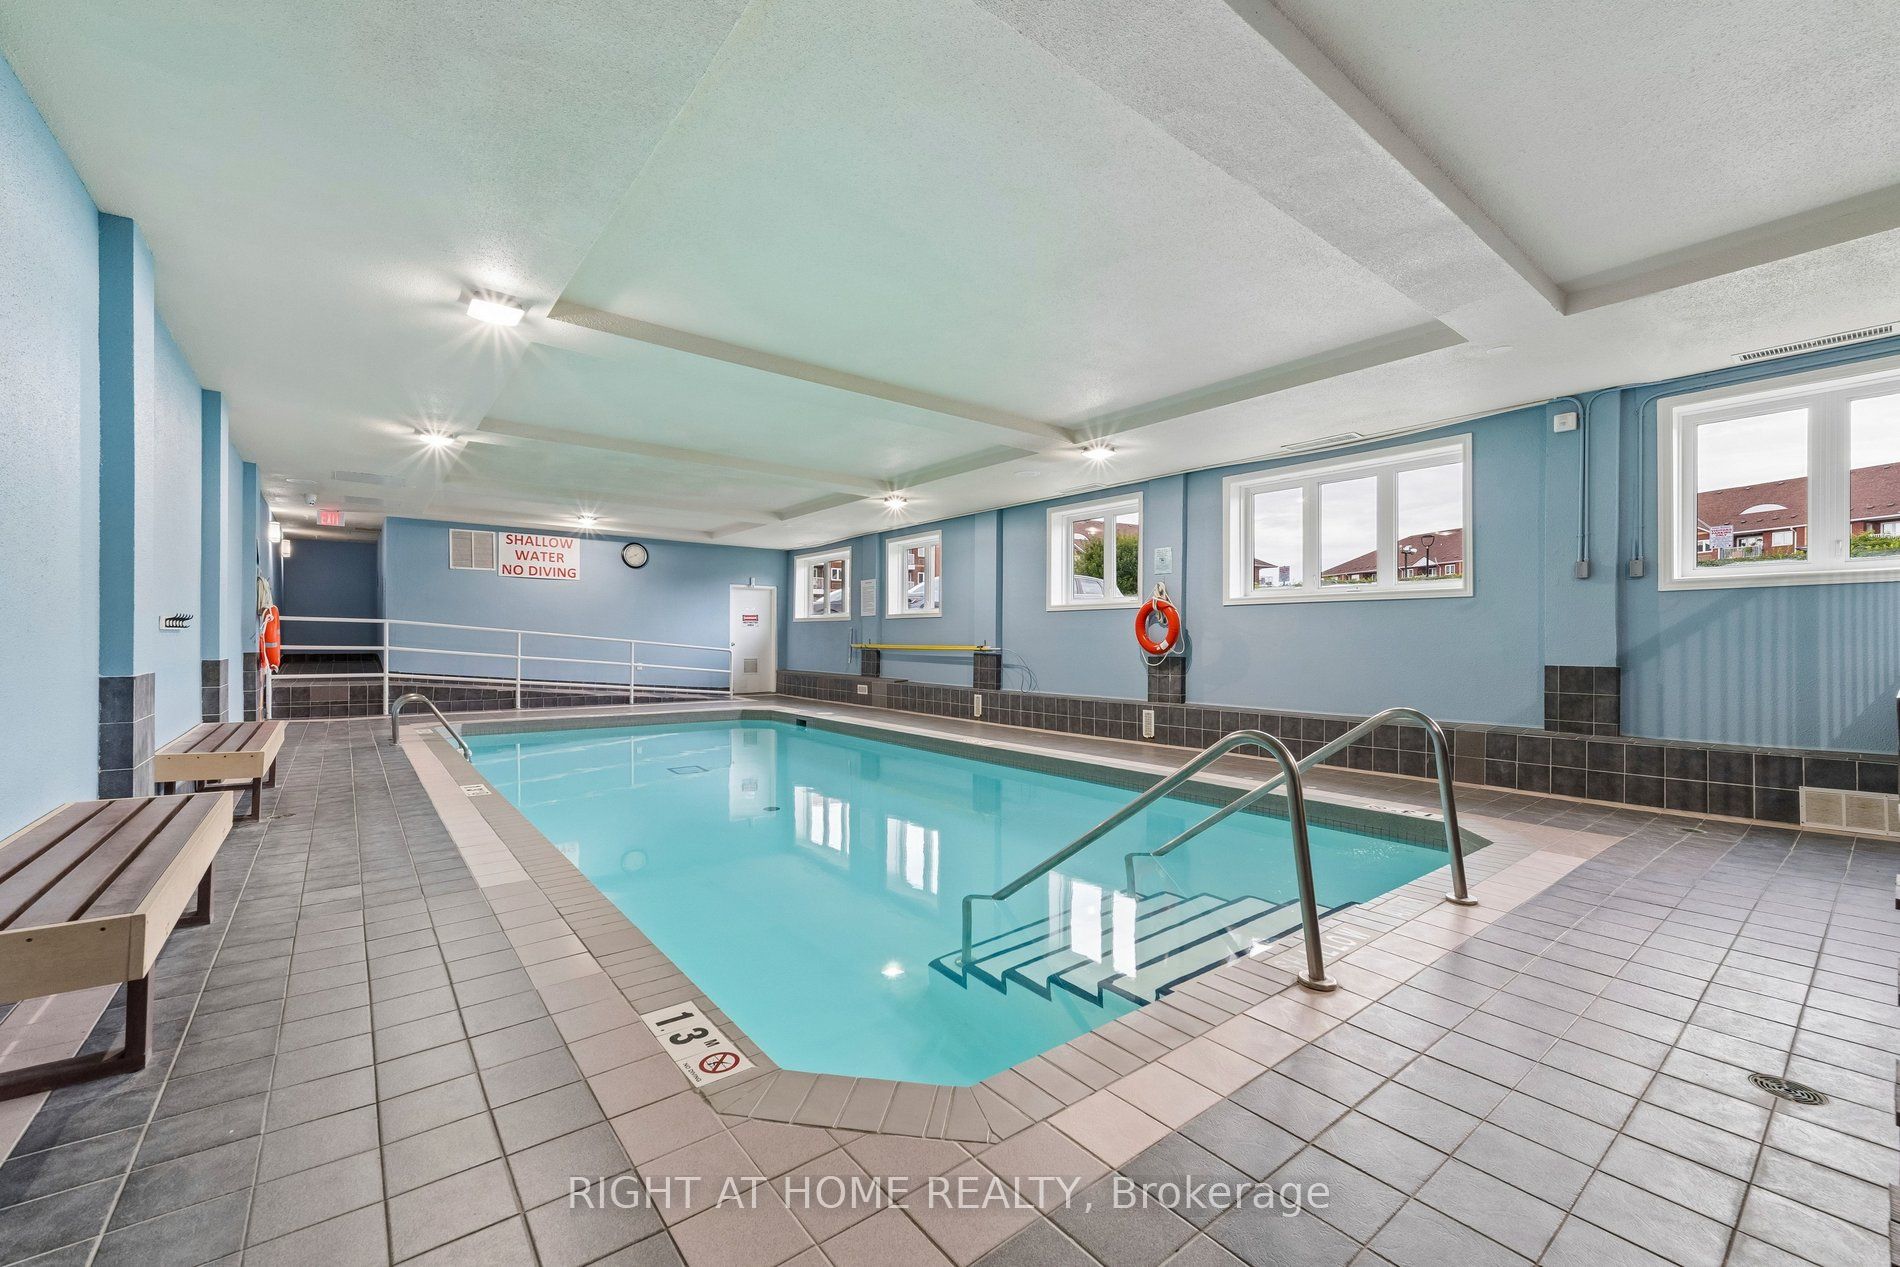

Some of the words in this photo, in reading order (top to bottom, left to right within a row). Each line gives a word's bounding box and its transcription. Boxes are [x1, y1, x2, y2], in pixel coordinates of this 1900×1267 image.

[505, 534, 574, 549] SHALLOW
[515, 550, 565, 563] WATER
[502, 564, 524, 576] NO
[528, 566, 577, 578] DIVING
